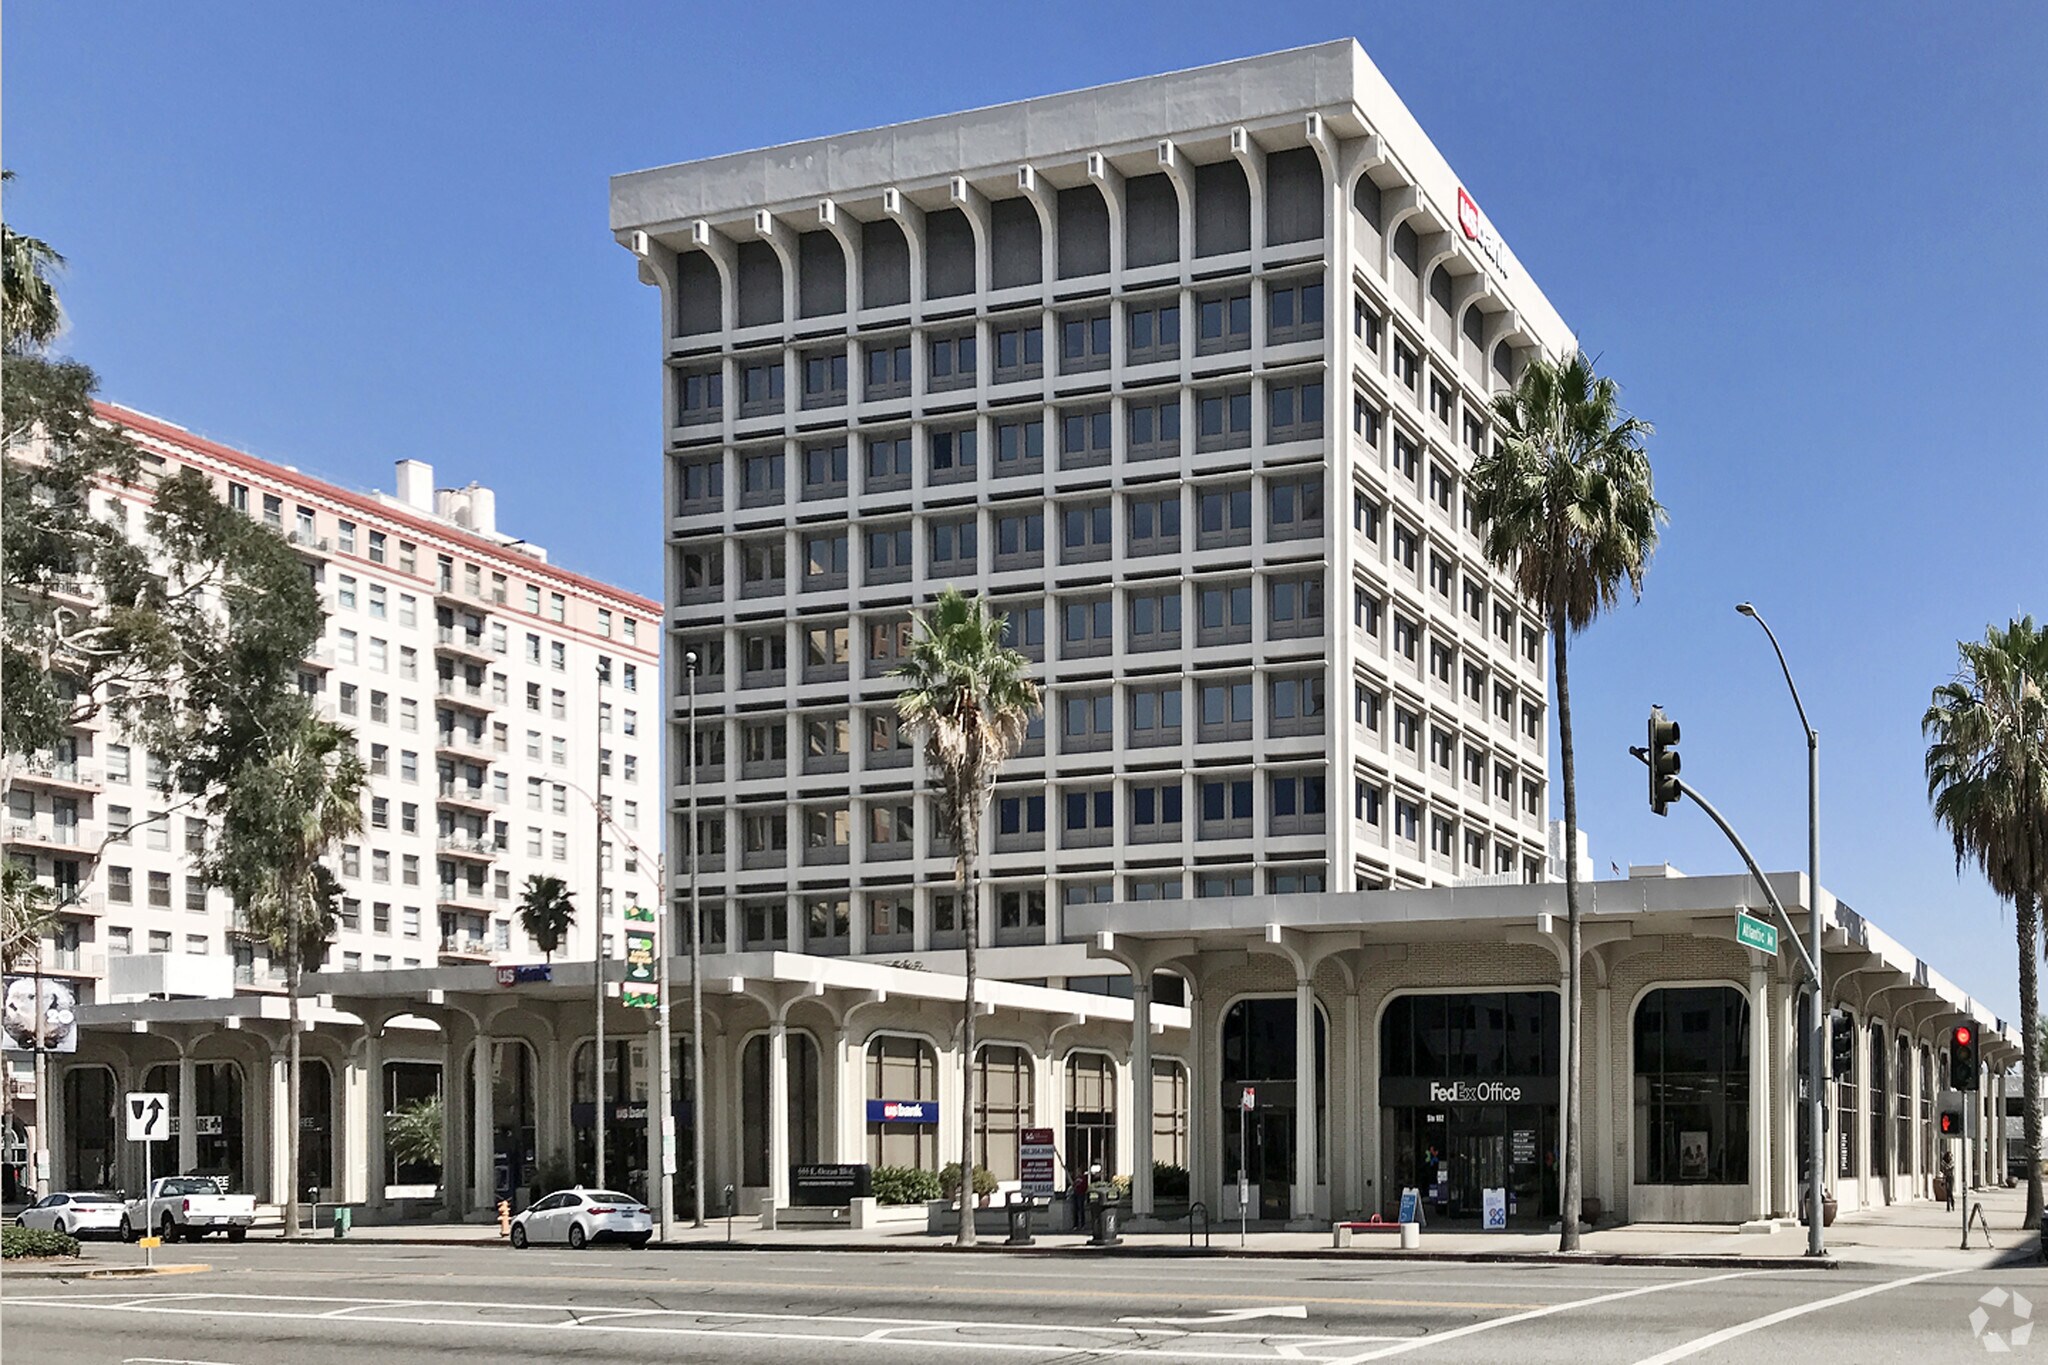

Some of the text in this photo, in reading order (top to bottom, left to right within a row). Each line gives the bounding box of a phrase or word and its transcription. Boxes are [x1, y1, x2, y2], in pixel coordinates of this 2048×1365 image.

[1742, 922, 1765, 943] Atlantic
[1430, 1081, 1521, 1102] FedEx Office
